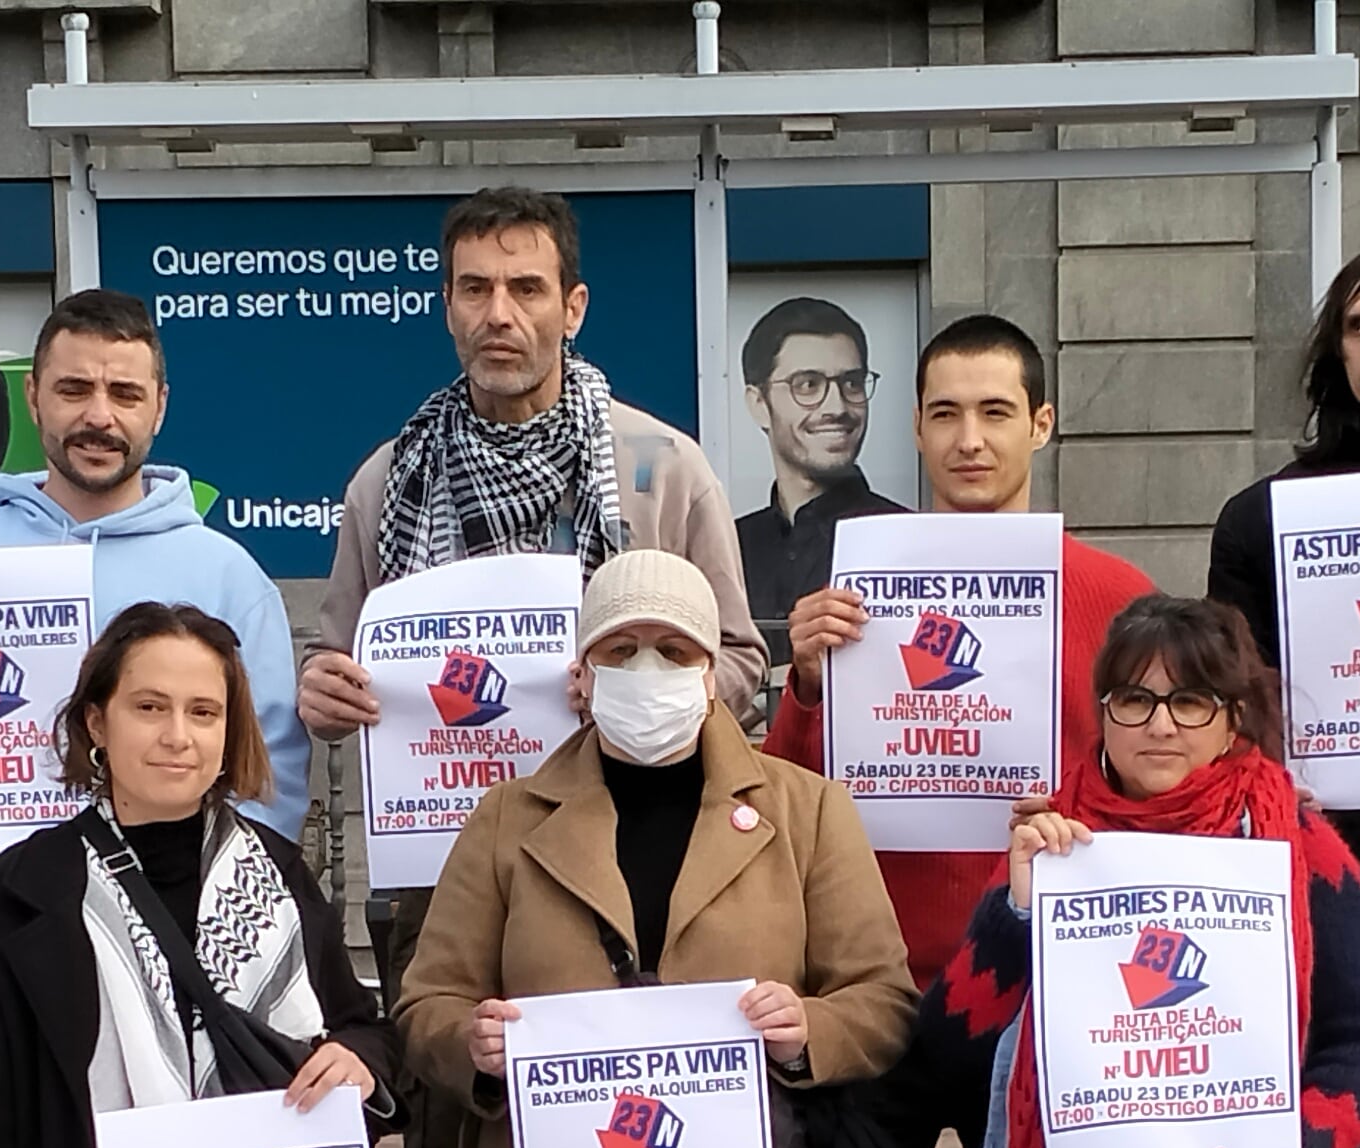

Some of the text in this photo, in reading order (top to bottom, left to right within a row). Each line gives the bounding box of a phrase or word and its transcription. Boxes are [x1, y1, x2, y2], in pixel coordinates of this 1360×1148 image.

[152, 243, 440, 281] Queremos que te
[156, 285, 436, 327] para ser tu mejor
[227, 496, 346, 535] Unicaja
[951, 576, 982, 599] PA
[987, 576, 1045, 598] VIVIR
[22, 604, 78, 627] VIVIR
[368, 613, 566, 644] ASTURIES PA VIVIR
[17, 720, 38, 734] LA
[845, 760, 1039, 779] SÁBADU 23 DE PAYARES
[1050, 890, 1273, 923] ASTURIES PA VIVIR
[526, 1046, 747, 1087] ASTURIES PA VIVIR
[1053, 1106, 1093, 1125] 17:00
[1105, 1100, 1207, 1118] C/POSTIGO
[1213, 1094, 1257, 1112] BAJO
[1263, 1092, 1286, 1107] 46
